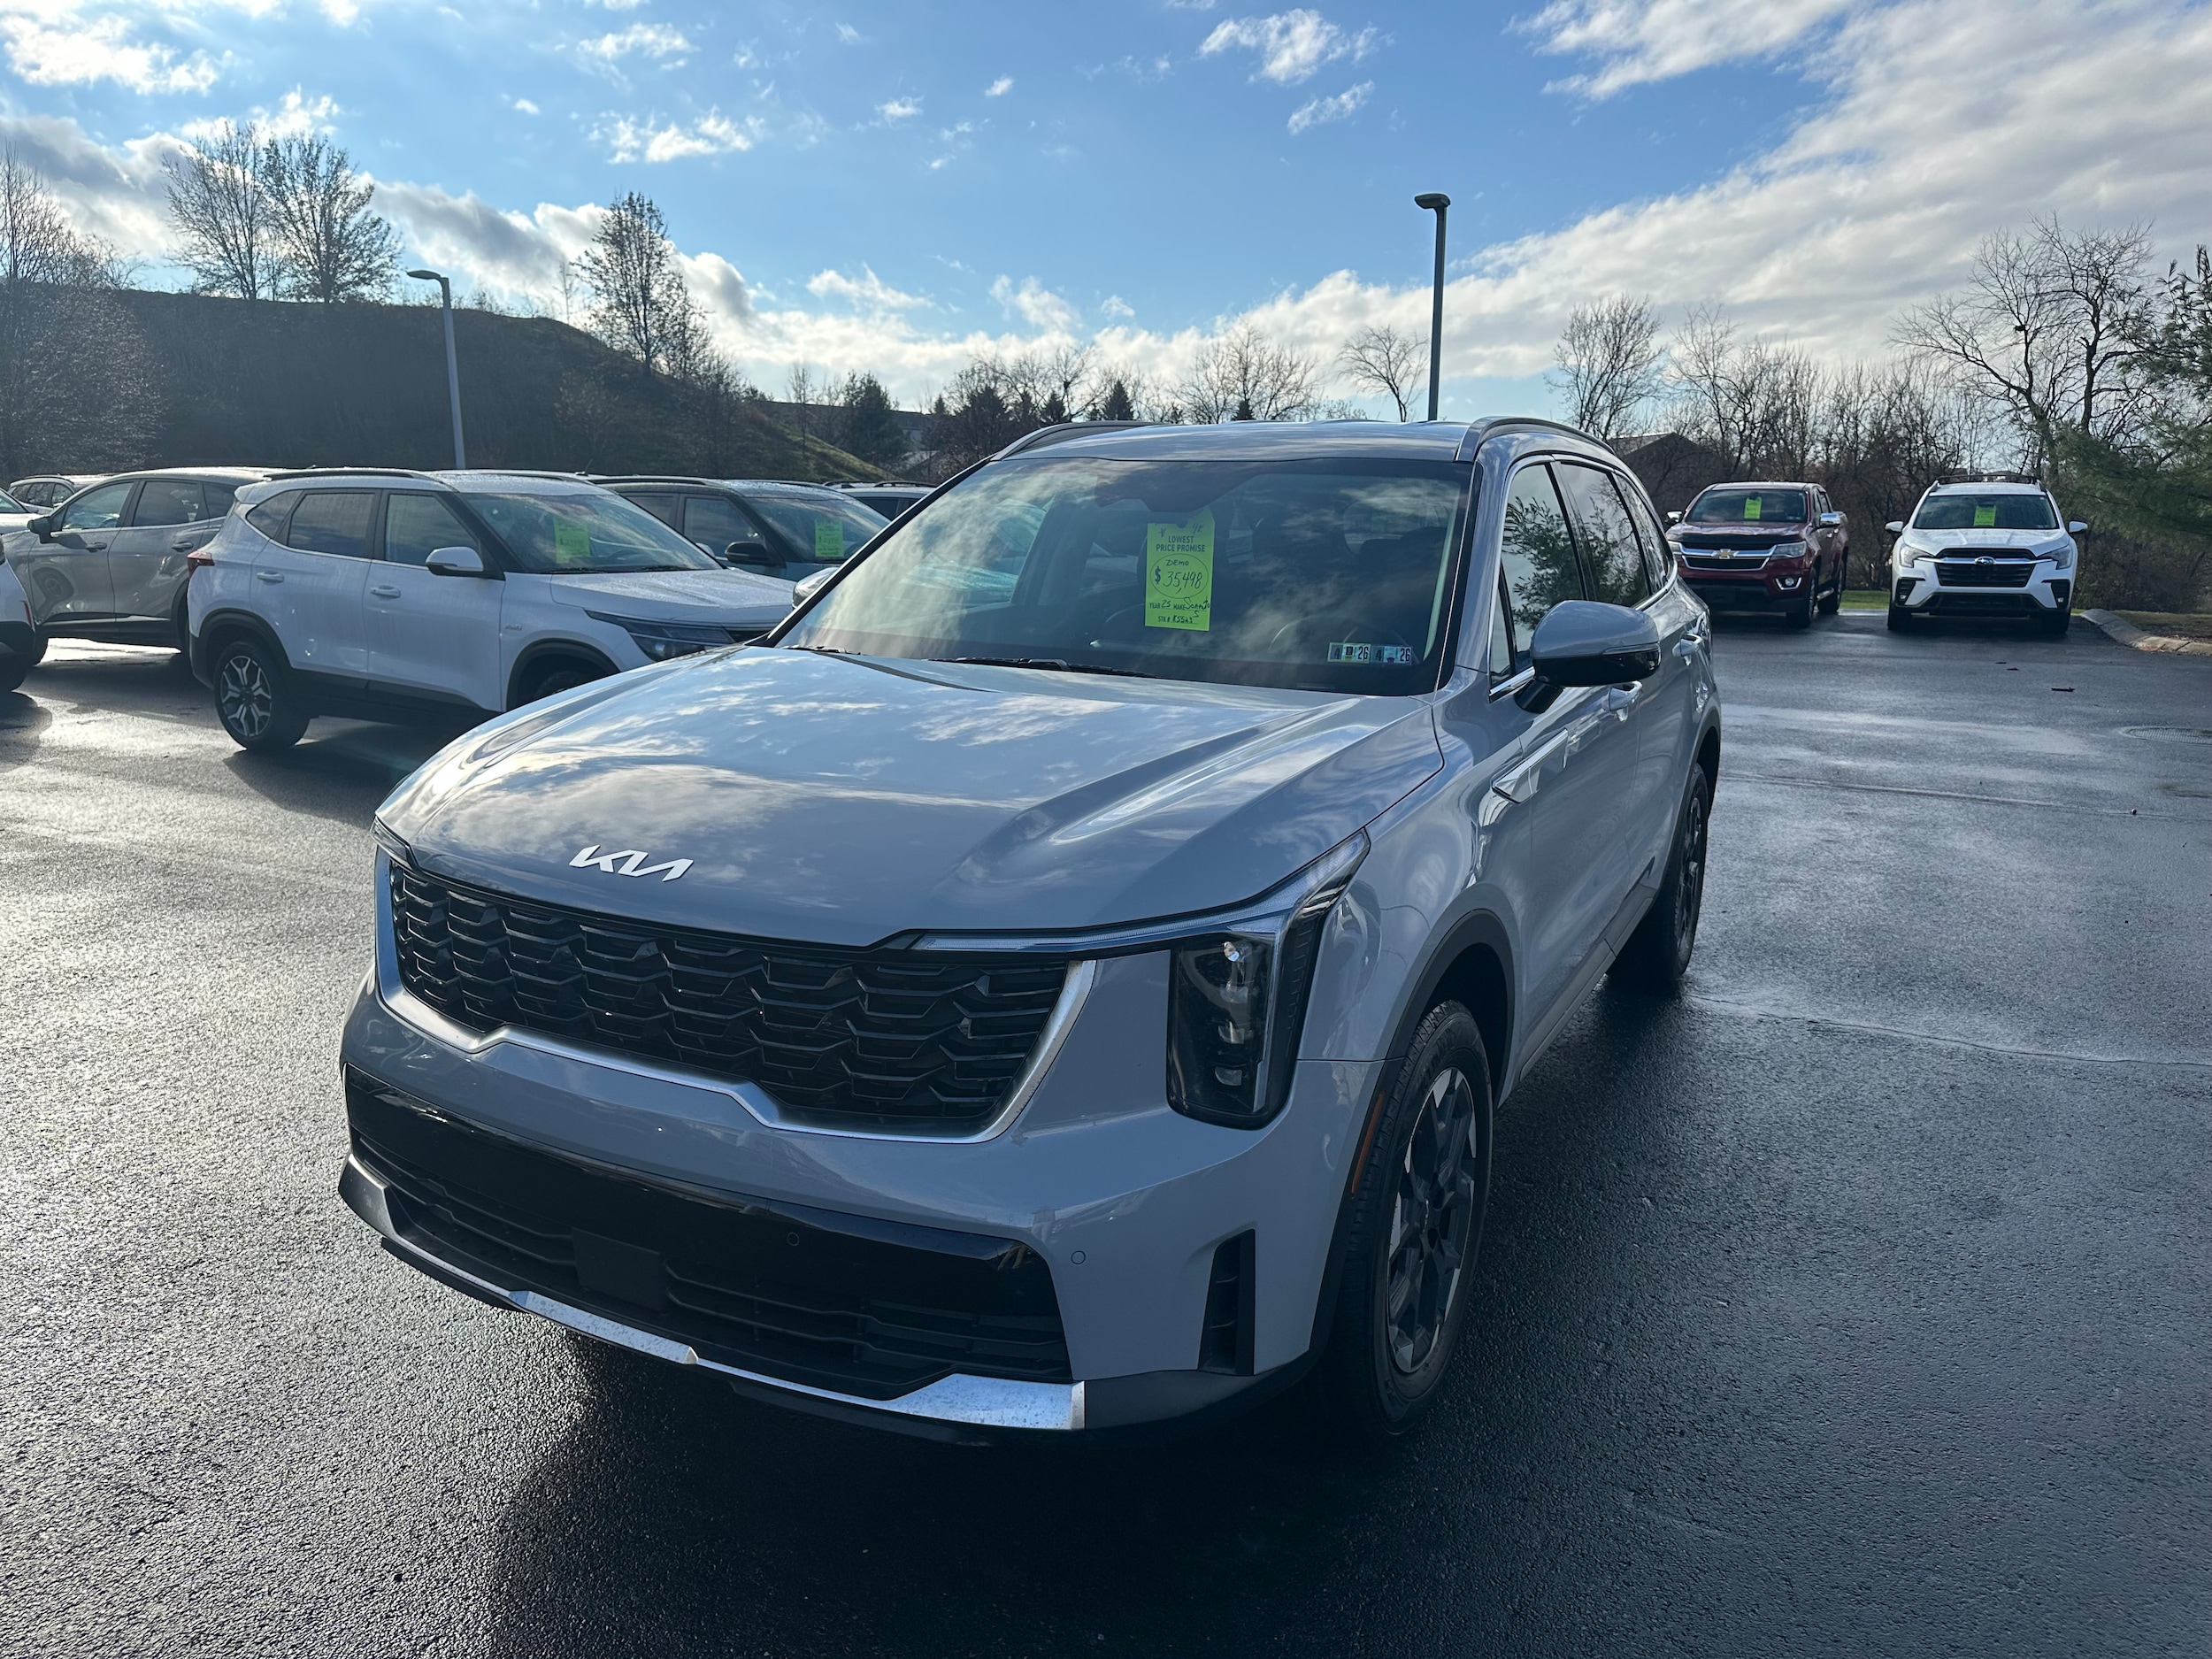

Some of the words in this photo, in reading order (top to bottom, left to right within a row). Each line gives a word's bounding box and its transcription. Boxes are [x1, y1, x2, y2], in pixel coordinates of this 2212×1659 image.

[1156, 543, 1175, 552] PRICE
[1161, 599, 1171, 609] 25
[1358, 646, 1369, 660] 26
[1400, 648, 1410, 662] 26
[569, 844, 694, 882] KIA
